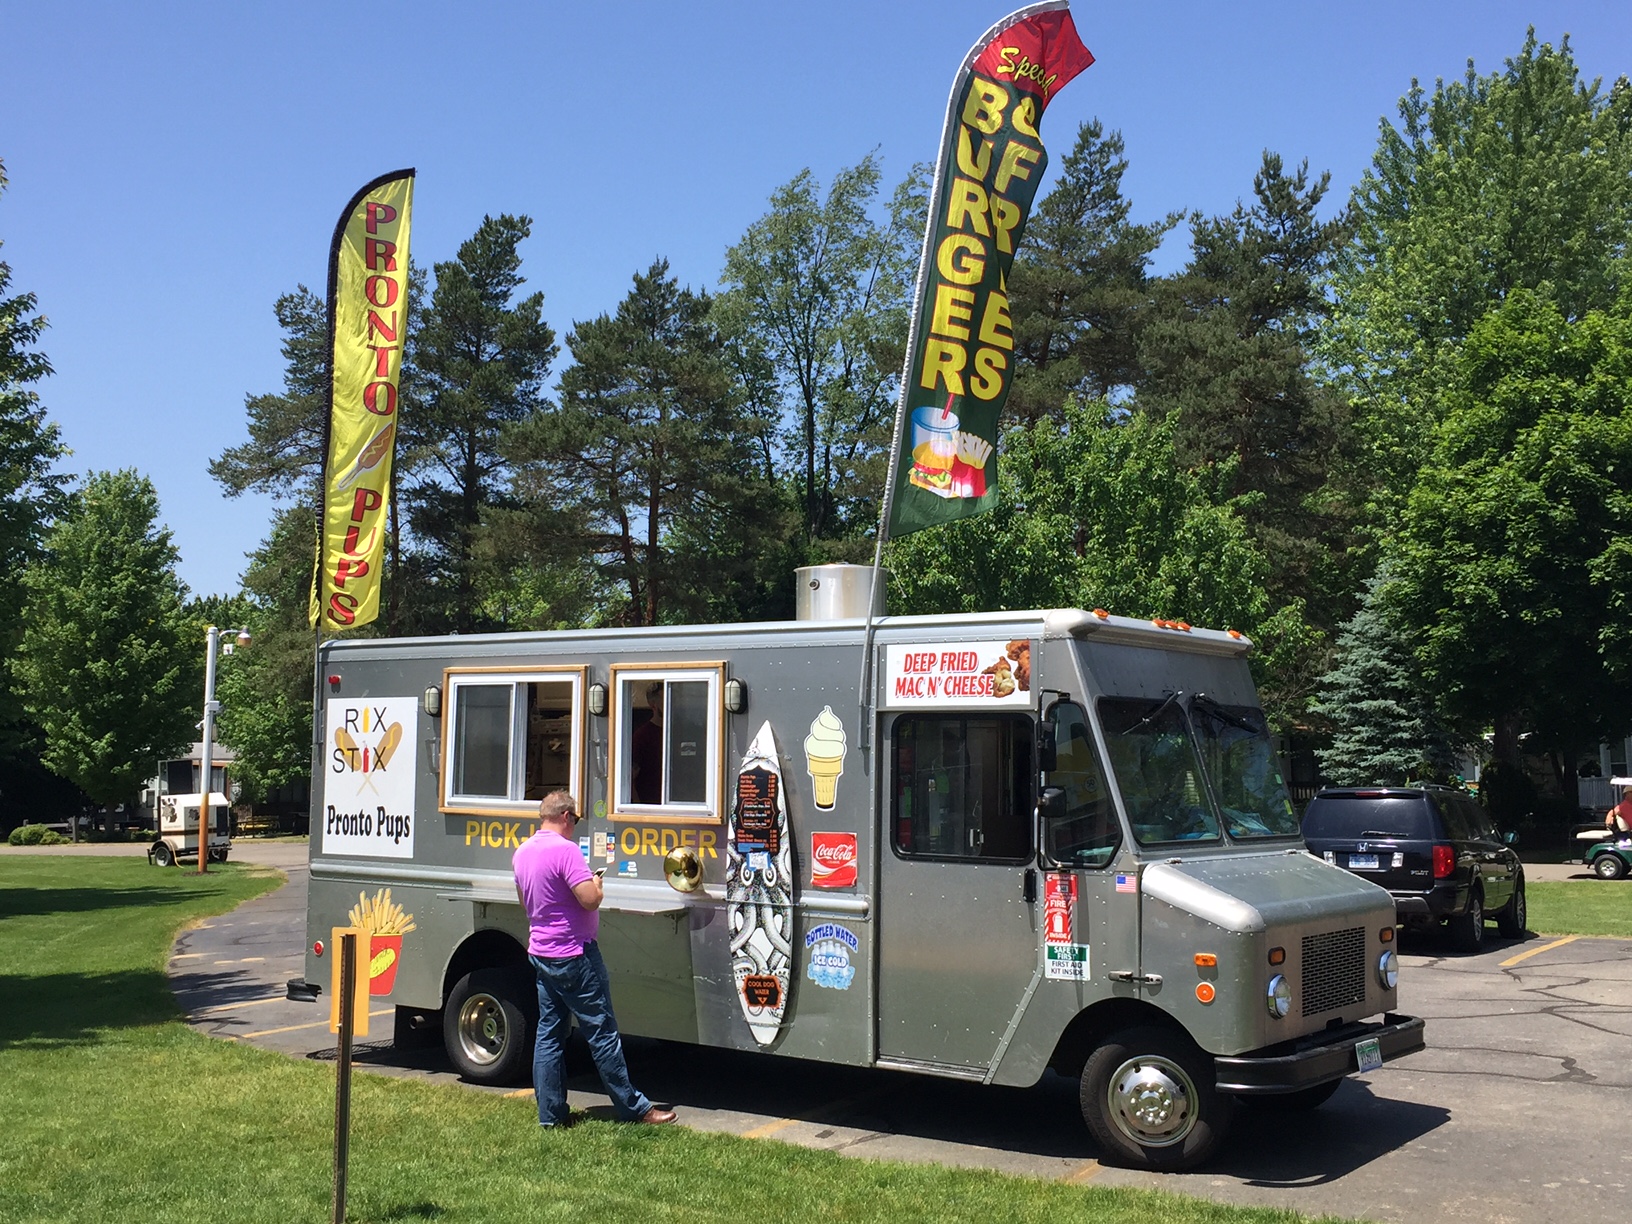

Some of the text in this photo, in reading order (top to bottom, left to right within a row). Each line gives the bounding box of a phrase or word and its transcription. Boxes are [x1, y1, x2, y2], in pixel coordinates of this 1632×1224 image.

[920, 77, 1009, 396] BURGER
[970, 140, 1042, 400] FRES
[364, 202, 399, 415] PRONTO
[327, 487, 382, 625] PUPS
[903, 651, 978, 674] DEEP FRIED
[895, 675, 995, 697] MAC N' CHEESE
[345, 706, 387, 733] RIX
[332, 746, 387, 774] STIX
[326, 804, 411, 845] Pronto Pups
[465, 820, 535, 849] PICK-
[620, 826, 719, 859] ORDER
[805, 925, 858, 951] BOTTLED WATER
[1053, 947, 1079, 955] SAFETY
[813, 954, 848, 967] ICE COLD
[1062, 968, 1084, 976] INSIDE
